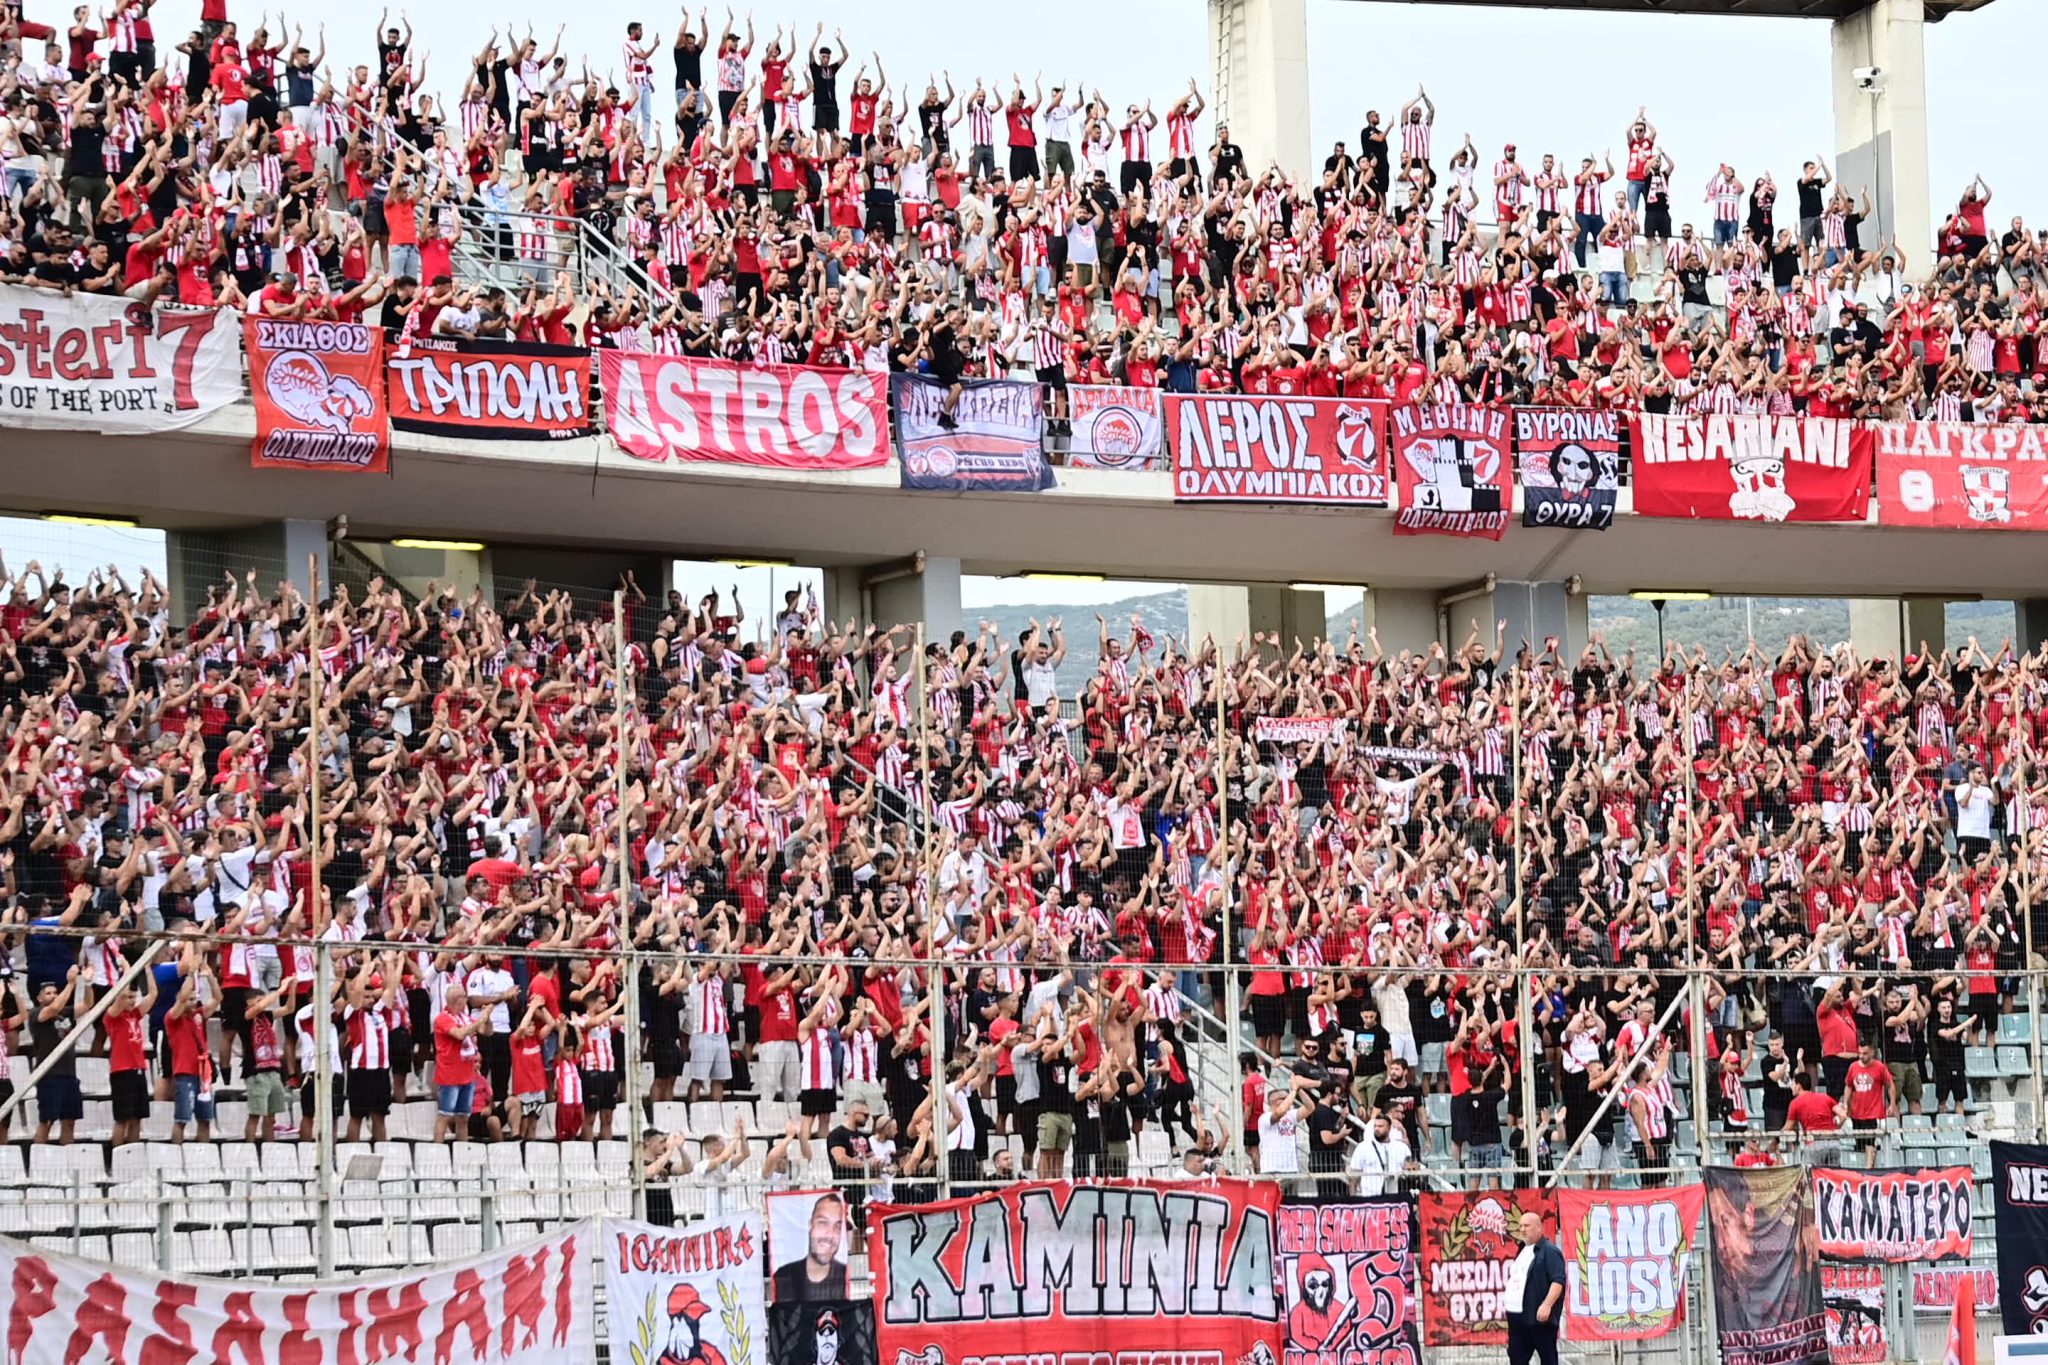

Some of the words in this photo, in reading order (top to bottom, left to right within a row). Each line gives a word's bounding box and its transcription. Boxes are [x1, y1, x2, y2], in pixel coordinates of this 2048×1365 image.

[256, 320, 370, 353] ΣΚΙΑΘΟΣ
[393, 333, 459, 352] ΟΥΜΠΙΑΚΟΣ
[10, 386, 38, 410] OF
[46, 386, 93, 414] THE
[100, 386, 158, 412] PORT
[388, 355, 585, 424] ΤΡΙΠΟΛΗ
[613, 359, 878, 458] ASTROS
[1179, 400, 1322, 470] ΛΕΡΟΣ
[1393, 402, 1506, 440] ΜΕΘΩΝΗ
[1517, 411, 1620, 441] ΒΥΡΩΝΑΣ
[1641, 412, 1851, 468] KESARIANI
[263, 429, 379, 465] ΟΛΥΜΠΙΑΚΟΣ
[1879, 420, 2048, 461] ΠΑΓΚΡΑ
[999, 458, 1026, 468] REDS
[1178, 470, 1385, 498] ΟΛΥΜΠΙΑΚΟΣ
[1398, 508, 1508, 533] ΟΛΥΜΠΙΑΚΟΣ
[1535, 501, 1594, 526] ΘΥΡΑ
[1597, 504, 1613, 527] 7
[1320, 1206, 1409, 1252] SICKNESS
[1817, 1179, 1972, 1242] ΚΑΜΑΤΕΡΟ
[616, 1221, 754, 1274] IOANNINA
[1587, 1202, 1678, 1258] ANO
[883, 1185, 1281, 1324] KAMINIA
[1913, 1270, 1996, 1306] ΛΕΩΝΙΟ
